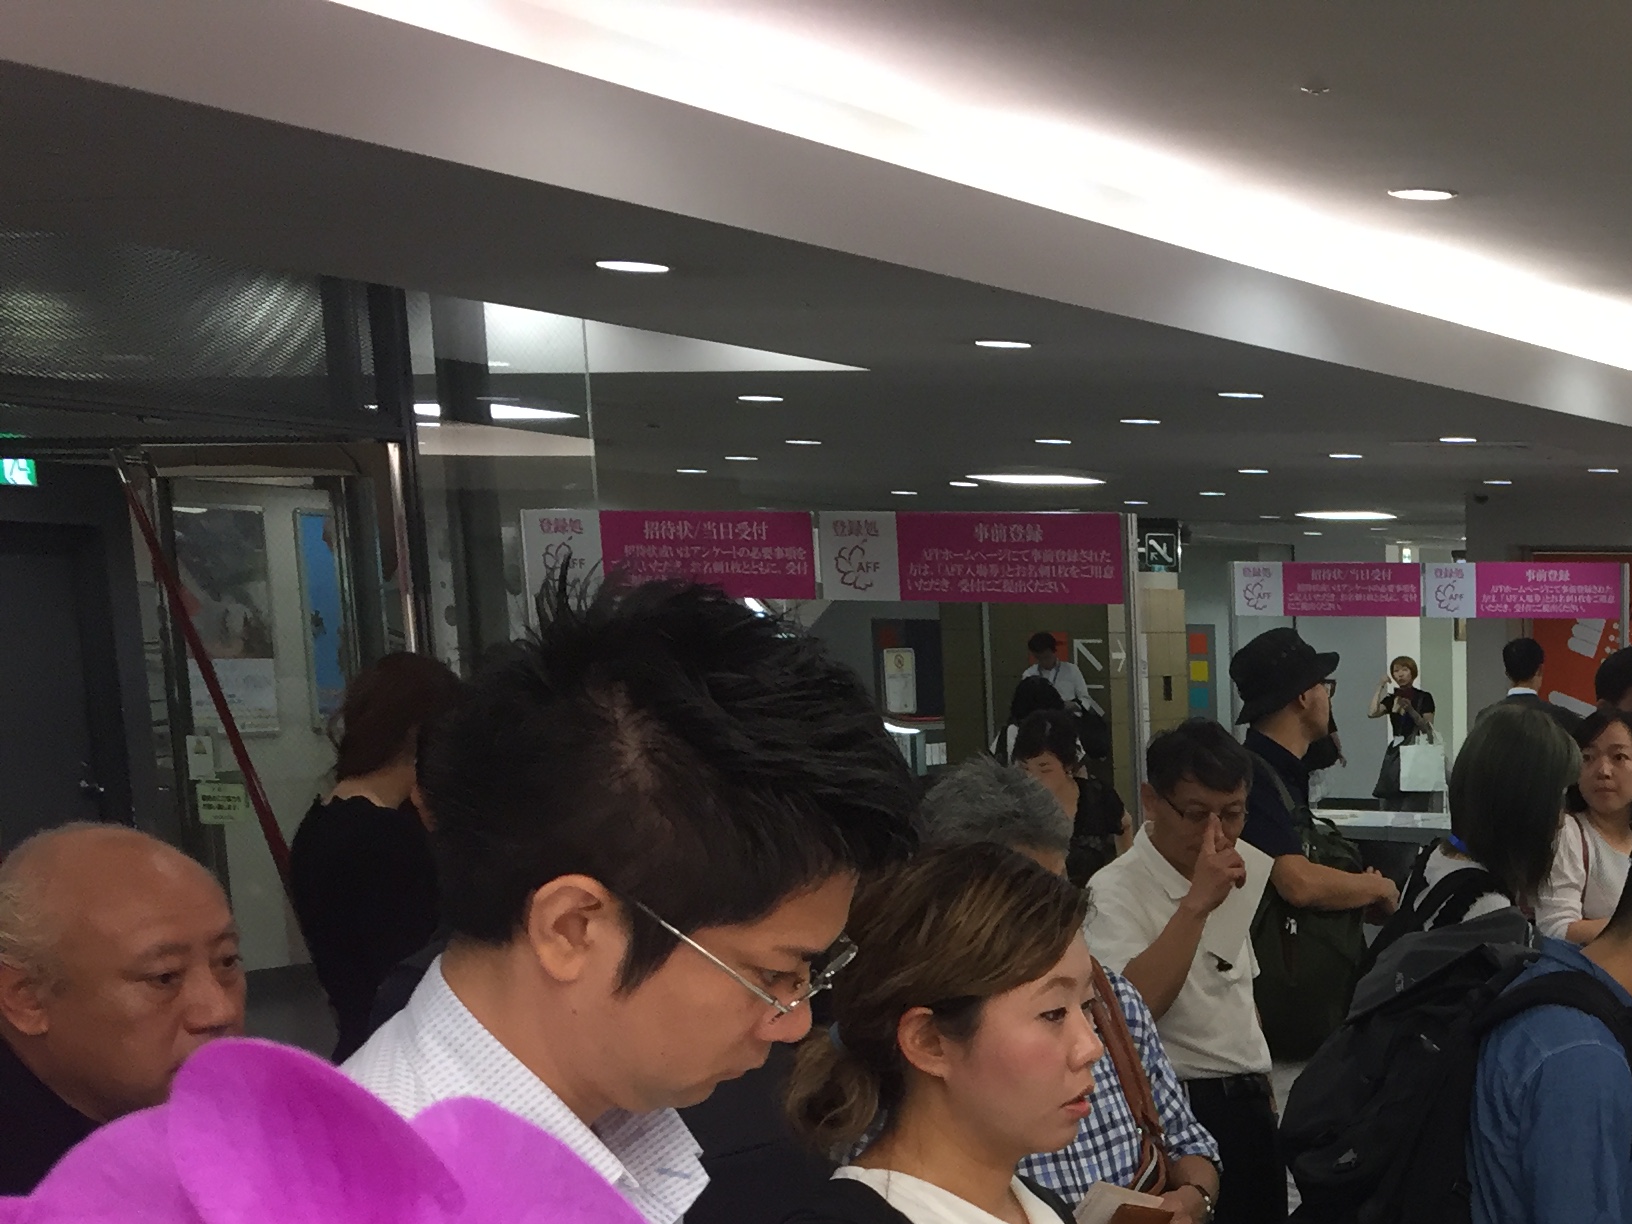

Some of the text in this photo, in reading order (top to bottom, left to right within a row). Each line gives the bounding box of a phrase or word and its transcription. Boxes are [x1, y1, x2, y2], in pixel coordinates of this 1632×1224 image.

[643, 520, 768, 541] 招待状/当日受付
[974, 523, 1044, 543] 事前登録
[856, 561, 880, 573] AFF
[1525, 569, 1571, 582] 事前登録
